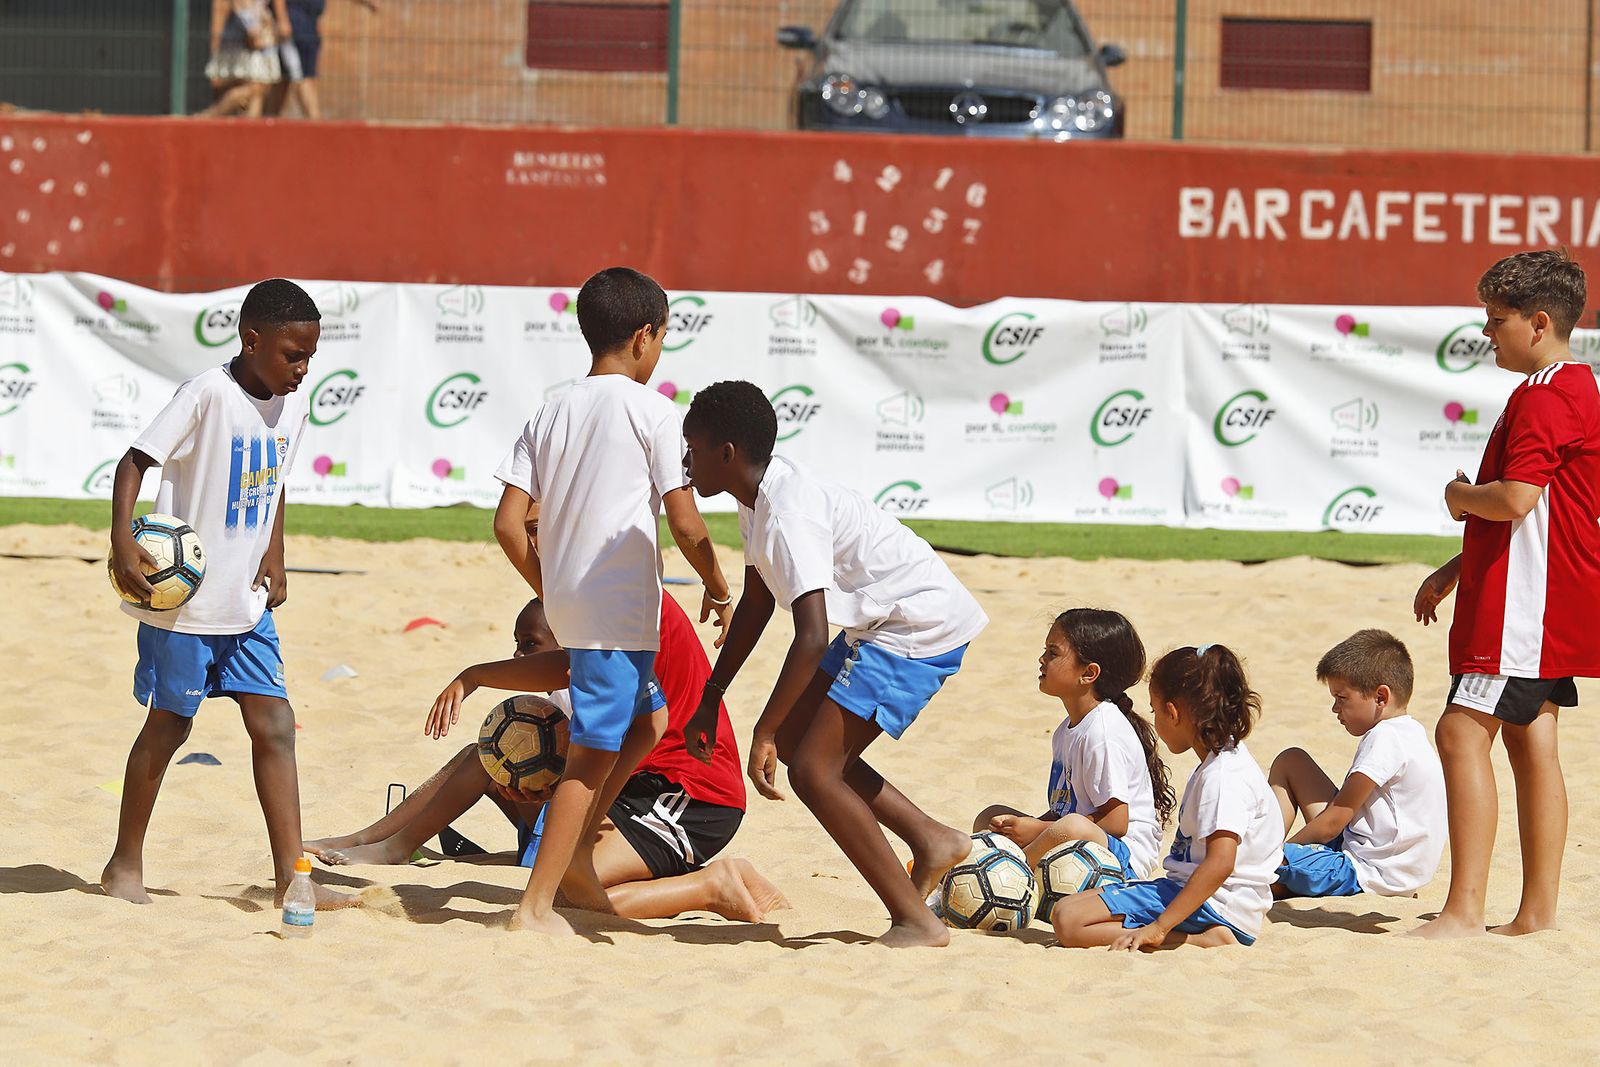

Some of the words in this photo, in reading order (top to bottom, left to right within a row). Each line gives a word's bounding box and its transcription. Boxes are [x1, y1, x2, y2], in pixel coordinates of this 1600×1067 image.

[1178, 186, 1291, 241] BAR
[207, 308, 241, 329] CSI
[668, 312, 713, 333] CSIF
[994, 326, 1045, 347] CSIF
[0, 378, 38, 400] SIF
[317, 385, 366, 407] CSIF
[438, 389, 489, 411] CSIF
[776, 401, 821, 423] CSIF
[1102, 407, 1152, 428] CSIF
[1225, 407, 1277, 428] CSIF
[240, 483, 277, 500] RECREATIV
[880, 497, 930, 512] CSIF
[1334, 503, 1384, 523] CSIF
